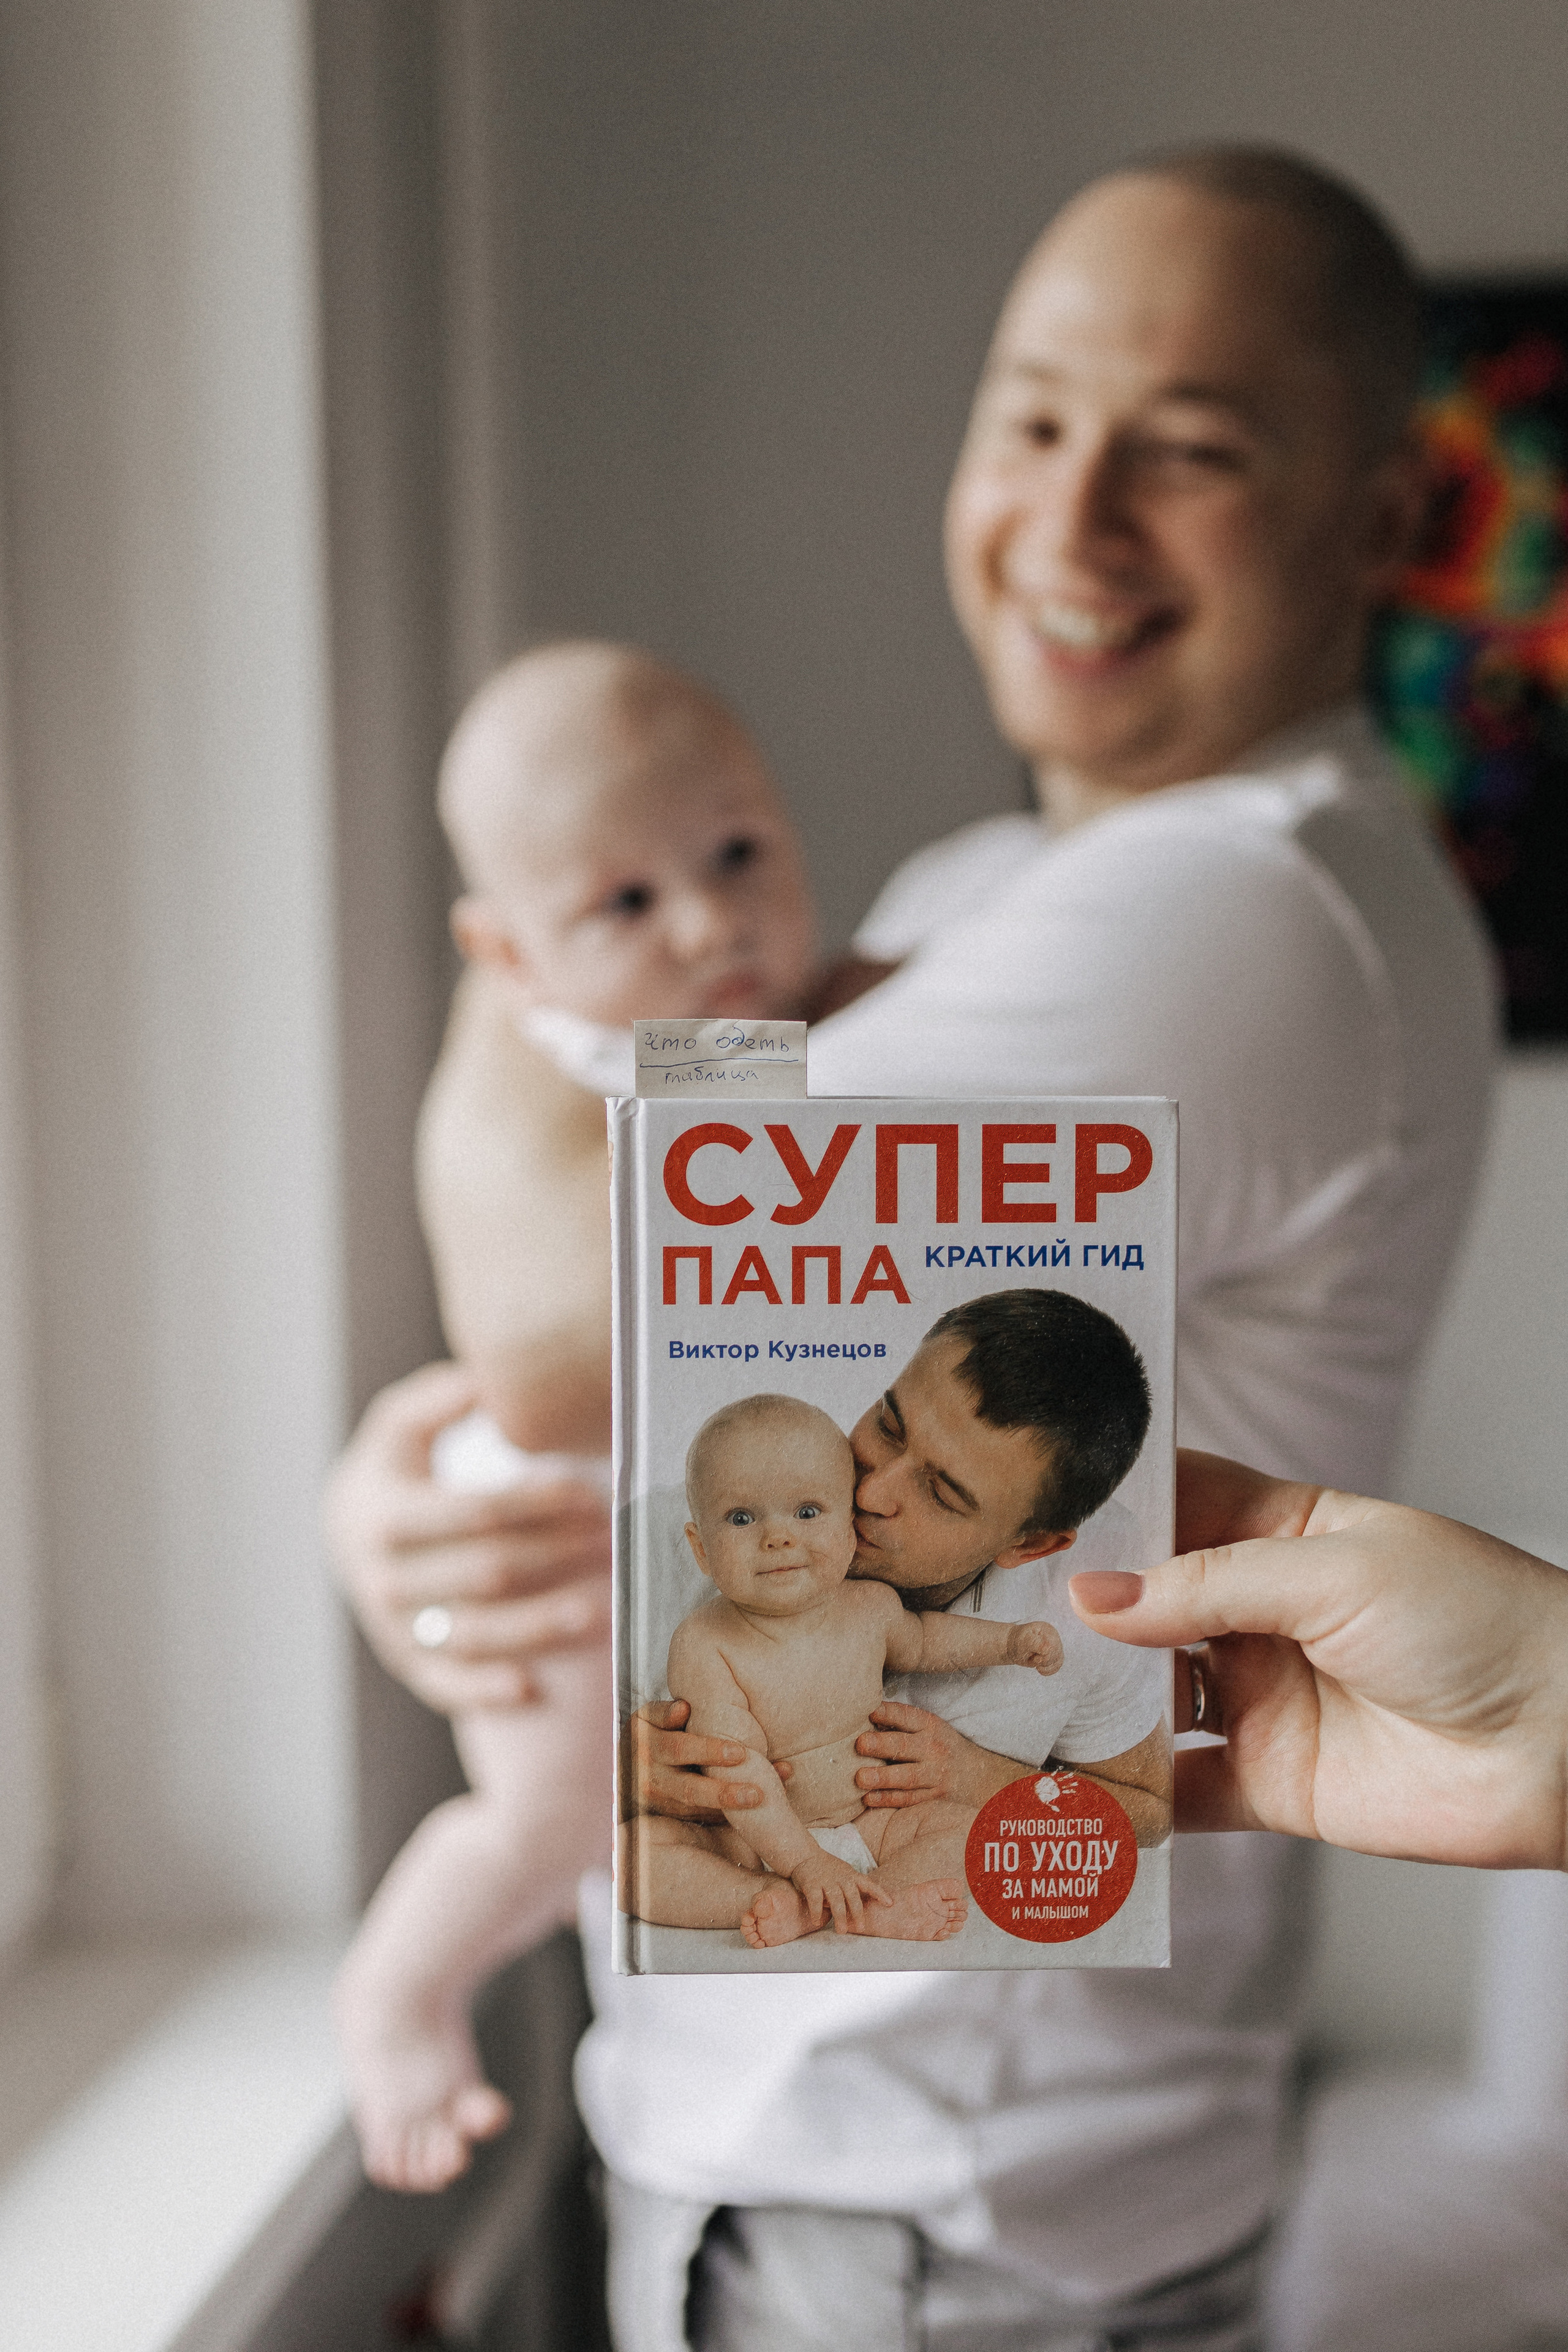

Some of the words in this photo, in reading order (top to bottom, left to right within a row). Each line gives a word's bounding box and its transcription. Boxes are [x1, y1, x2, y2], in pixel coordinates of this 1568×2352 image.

[644, 1032, 697, 1050] Что
[716, 1025, 790, 1052] одеть
[665, 1066, 759, 1085] таблица
[663, 1123, 1154, 1226] СУПЕР
[925, 1238, 1071, 1268] КРАТКИЙ
[1083, 1245, 1145, 1271] ГИД
[662, 1245, 912, 1305] ПАПА
[669, 1340, 760, 1362] Виктор
[767, 1340, 887, 1362] Кузнецов
[1000, 1818, 1102, 1838] РУКОВОДСТВО
[984, 1842, 1019, 1872] ПО
[1031, 1840, 1118, 1875] УХОДУ
[1002, 1879, 1023, 1899] ЗА
[1031, 1872, 1098, 1898] МАМОЙ
[1012, 1907, 1020, 1920] И
[1024, 1905, 1089, 1920] МАЛЫШОМ
